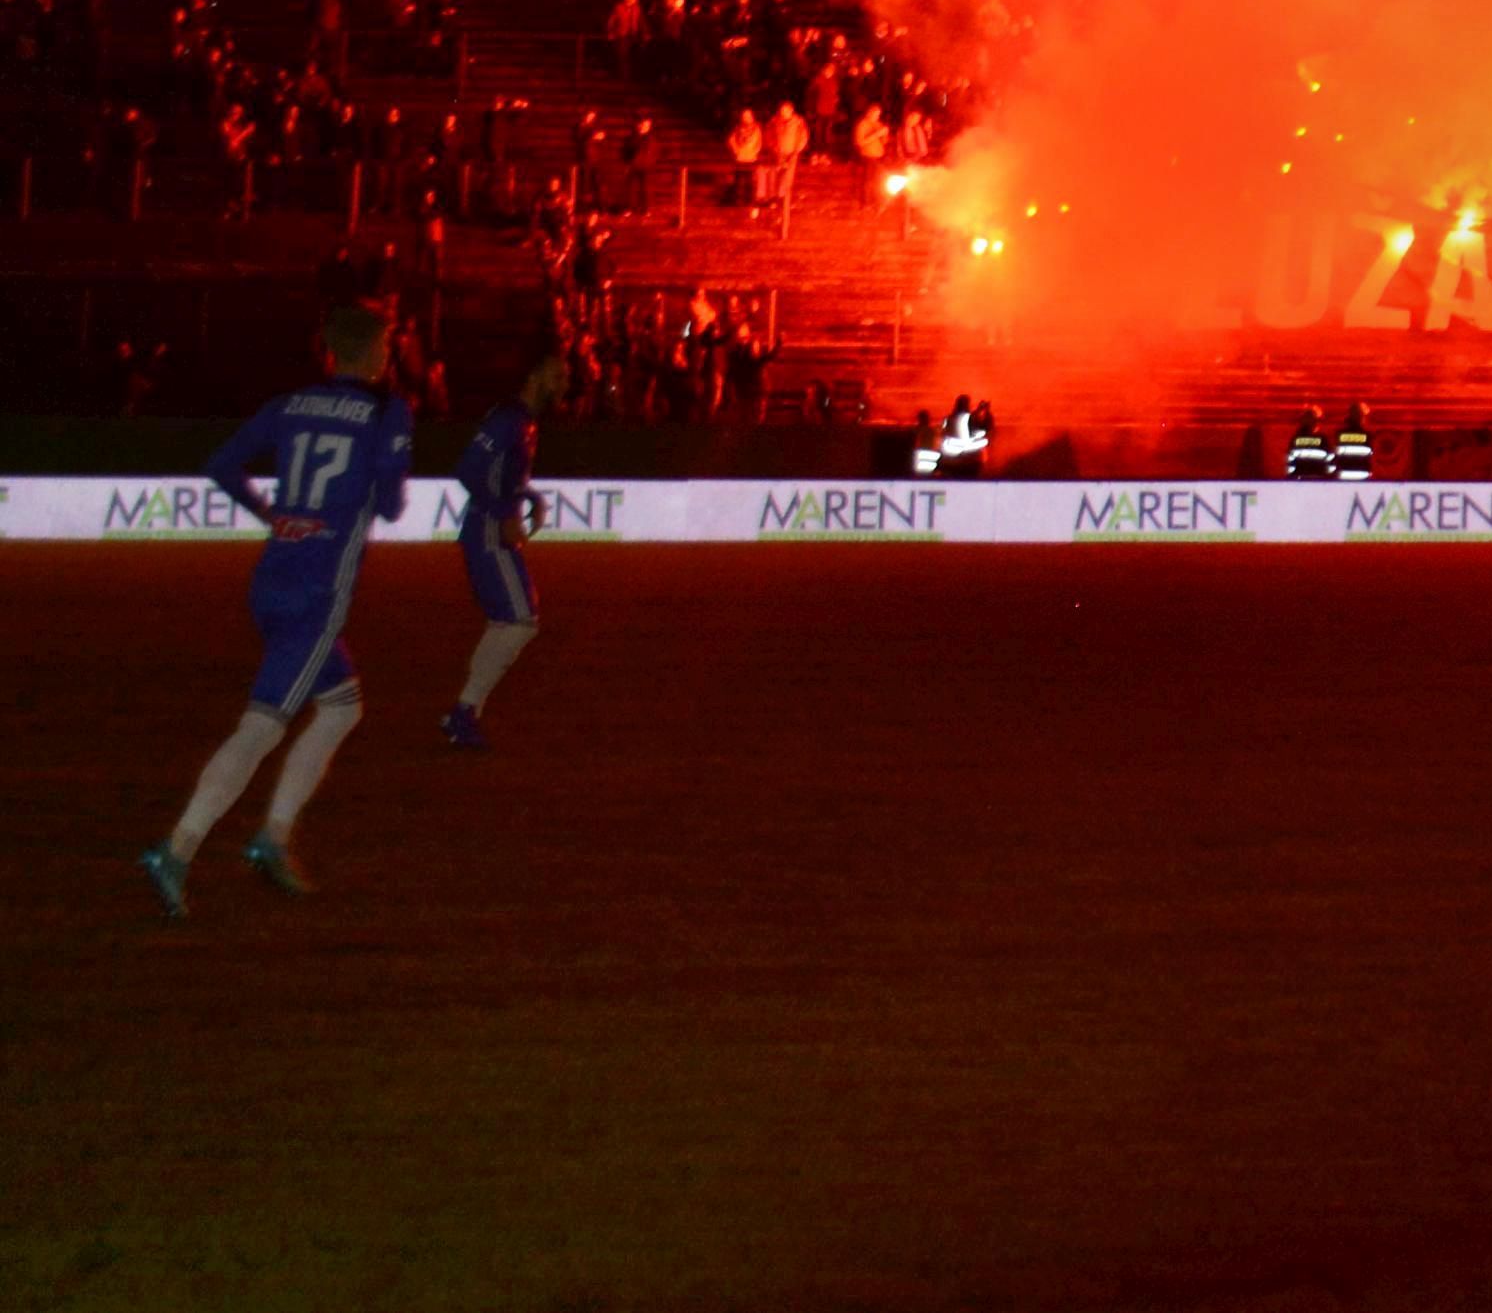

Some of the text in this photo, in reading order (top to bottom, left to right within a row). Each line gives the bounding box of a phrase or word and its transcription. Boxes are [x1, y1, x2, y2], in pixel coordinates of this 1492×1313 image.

[285, 431, 354, 510] 17
[761, 490, 946, 530] MARENT
[1075, 491, 1259, 531] MARENT
